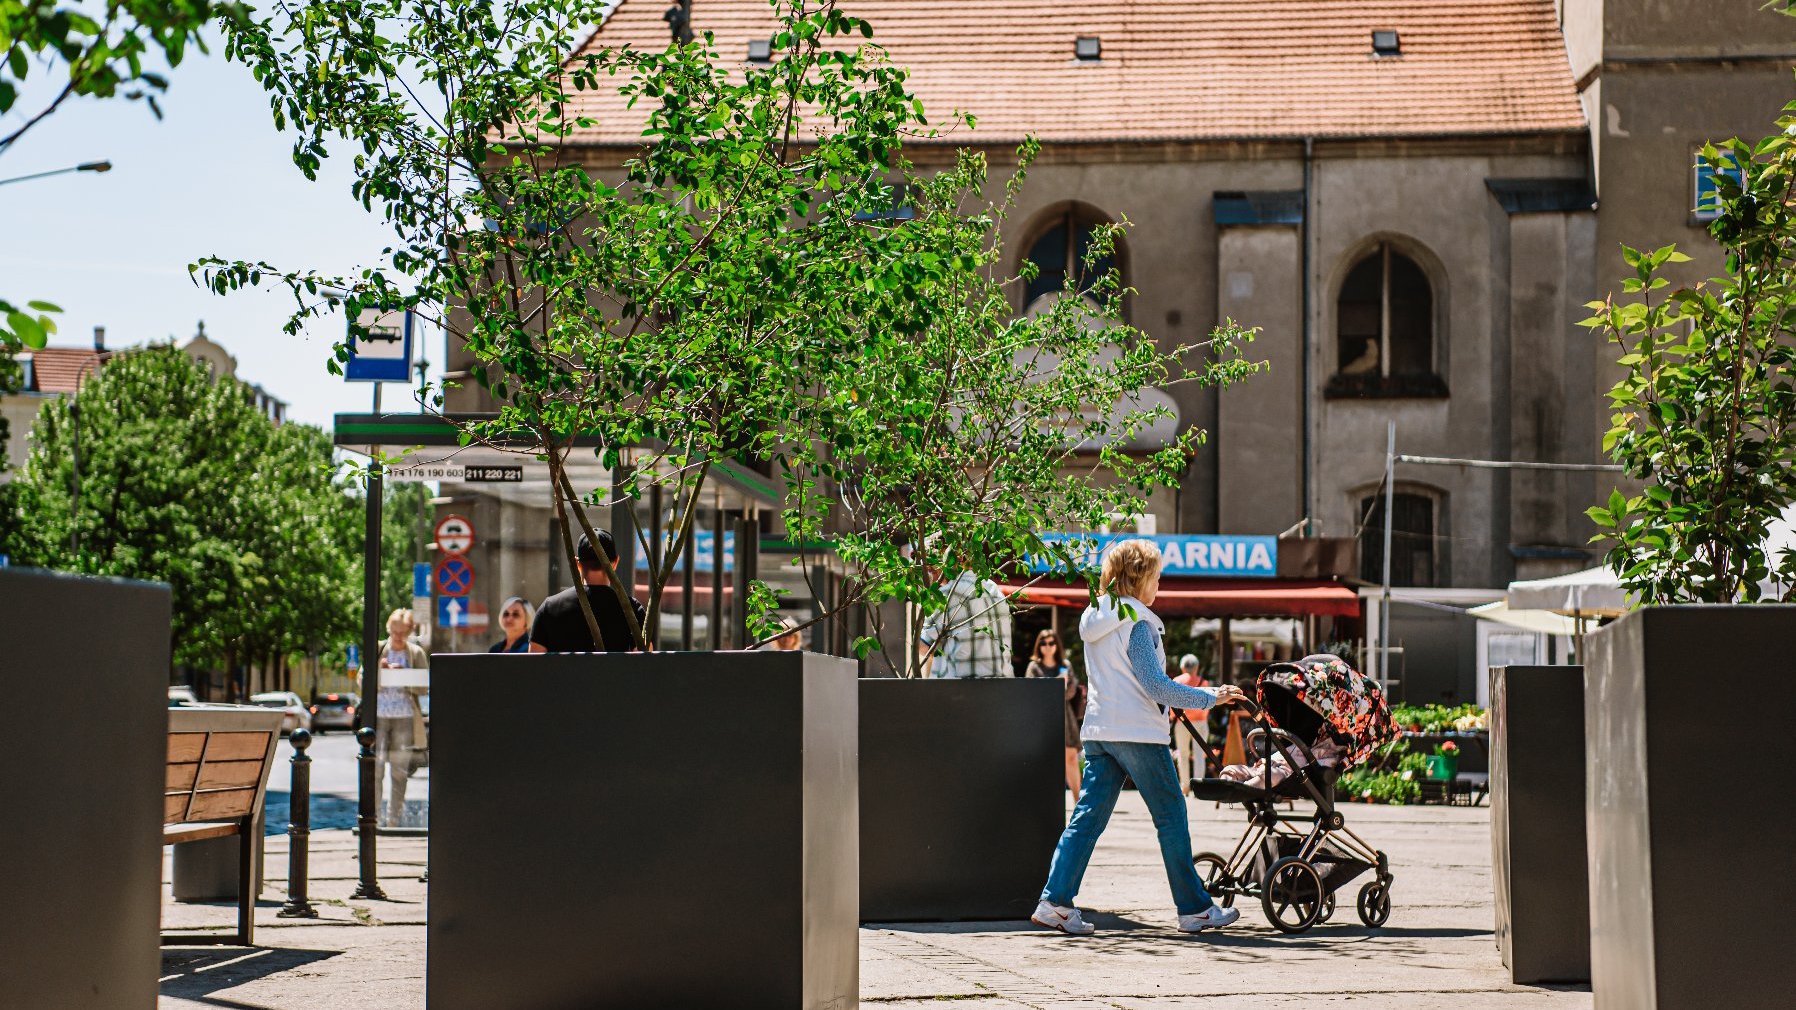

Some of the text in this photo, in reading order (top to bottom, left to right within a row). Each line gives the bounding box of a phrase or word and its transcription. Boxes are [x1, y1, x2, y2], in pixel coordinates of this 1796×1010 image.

[408, 468, 424, 477] 176
[428, 468, 444, 477] 190
[446, 469, 464, 477] 603
[465, 469, 483, 478] 211
[485, 469, 502, 478] 220
[505, 469, 522, 479] 221
